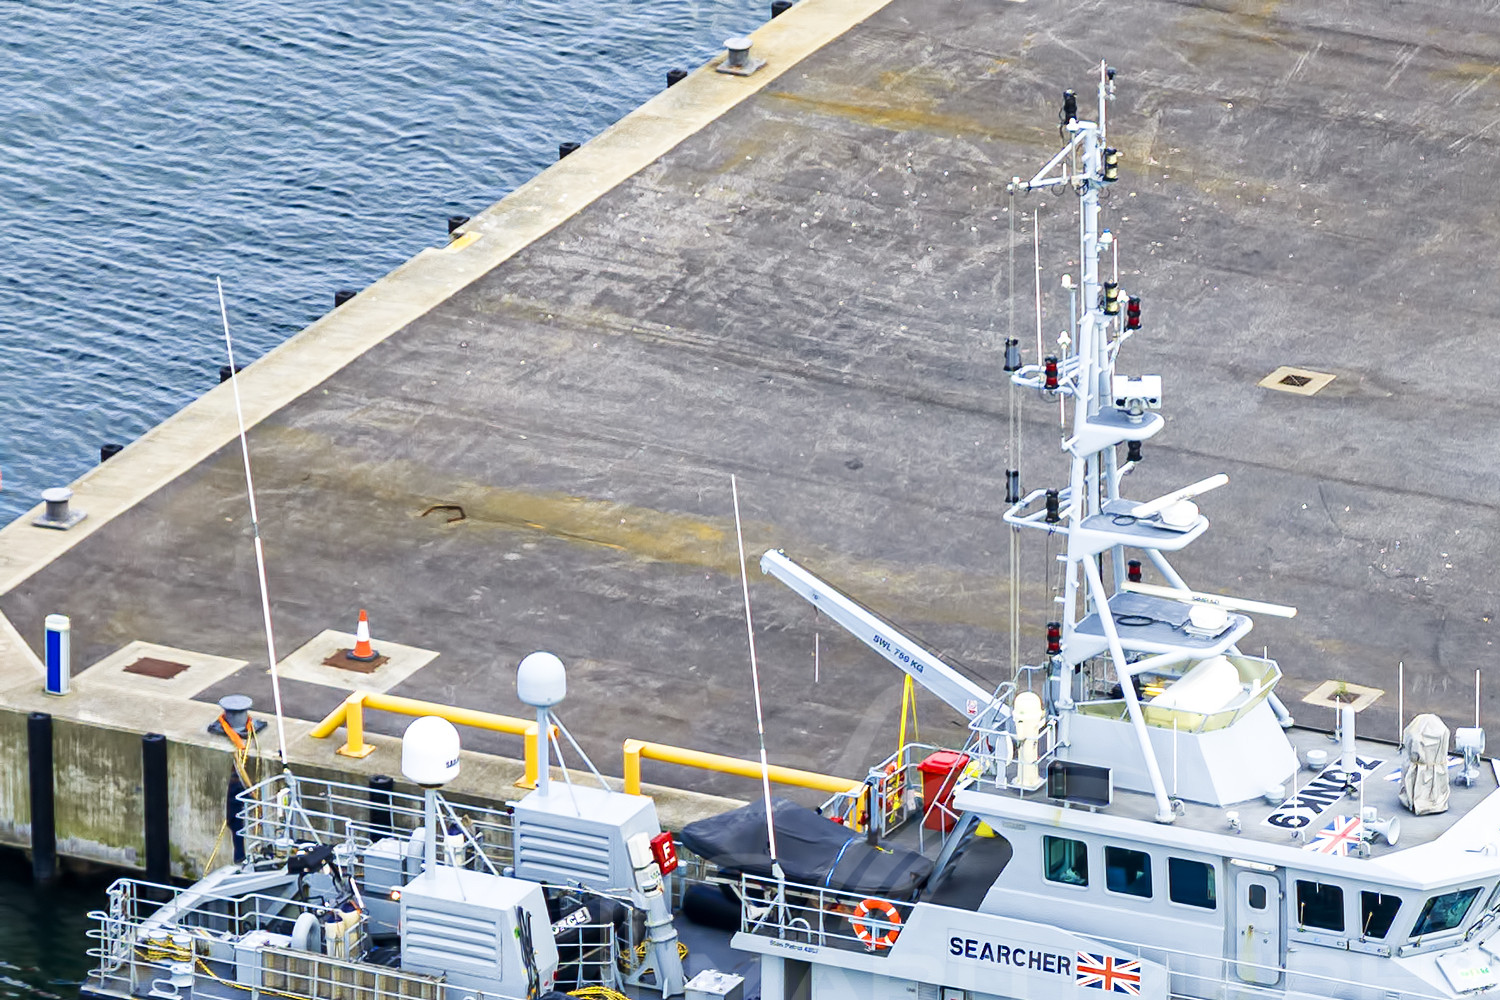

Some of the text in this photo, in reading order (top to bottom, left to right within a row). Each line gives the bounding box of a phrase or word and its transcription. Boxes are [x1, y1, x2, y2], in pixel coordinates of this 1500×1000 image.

[873, 635, 891, 651] SWL
[910, 660, 924, 673] KG
[949, 936, 1071, 976] SEARCHER
